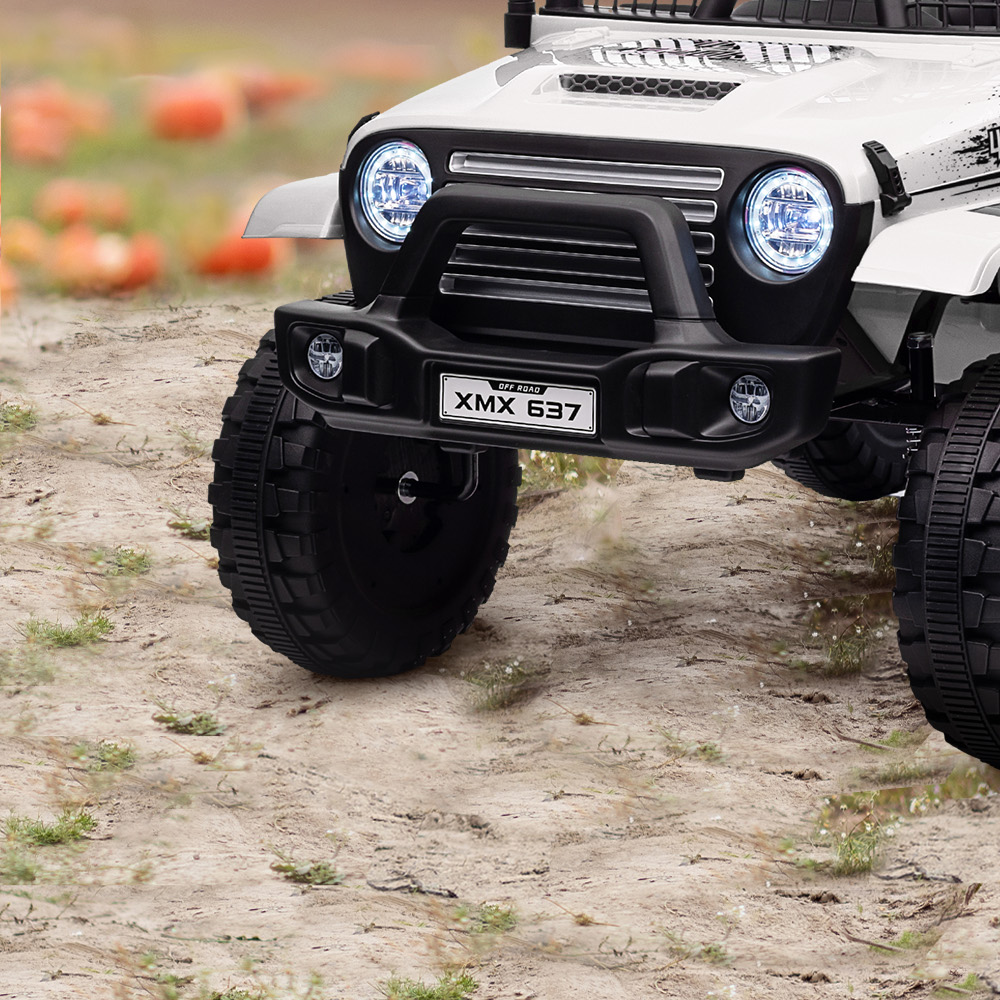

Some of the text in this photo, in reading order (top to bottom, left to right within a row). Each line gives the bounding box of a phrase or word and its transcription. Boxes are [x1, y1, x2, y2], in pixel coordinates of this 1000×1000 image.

[498, 383, 541, 394] OFF ROAD
[454, 391, 582, 421] XMX 637
